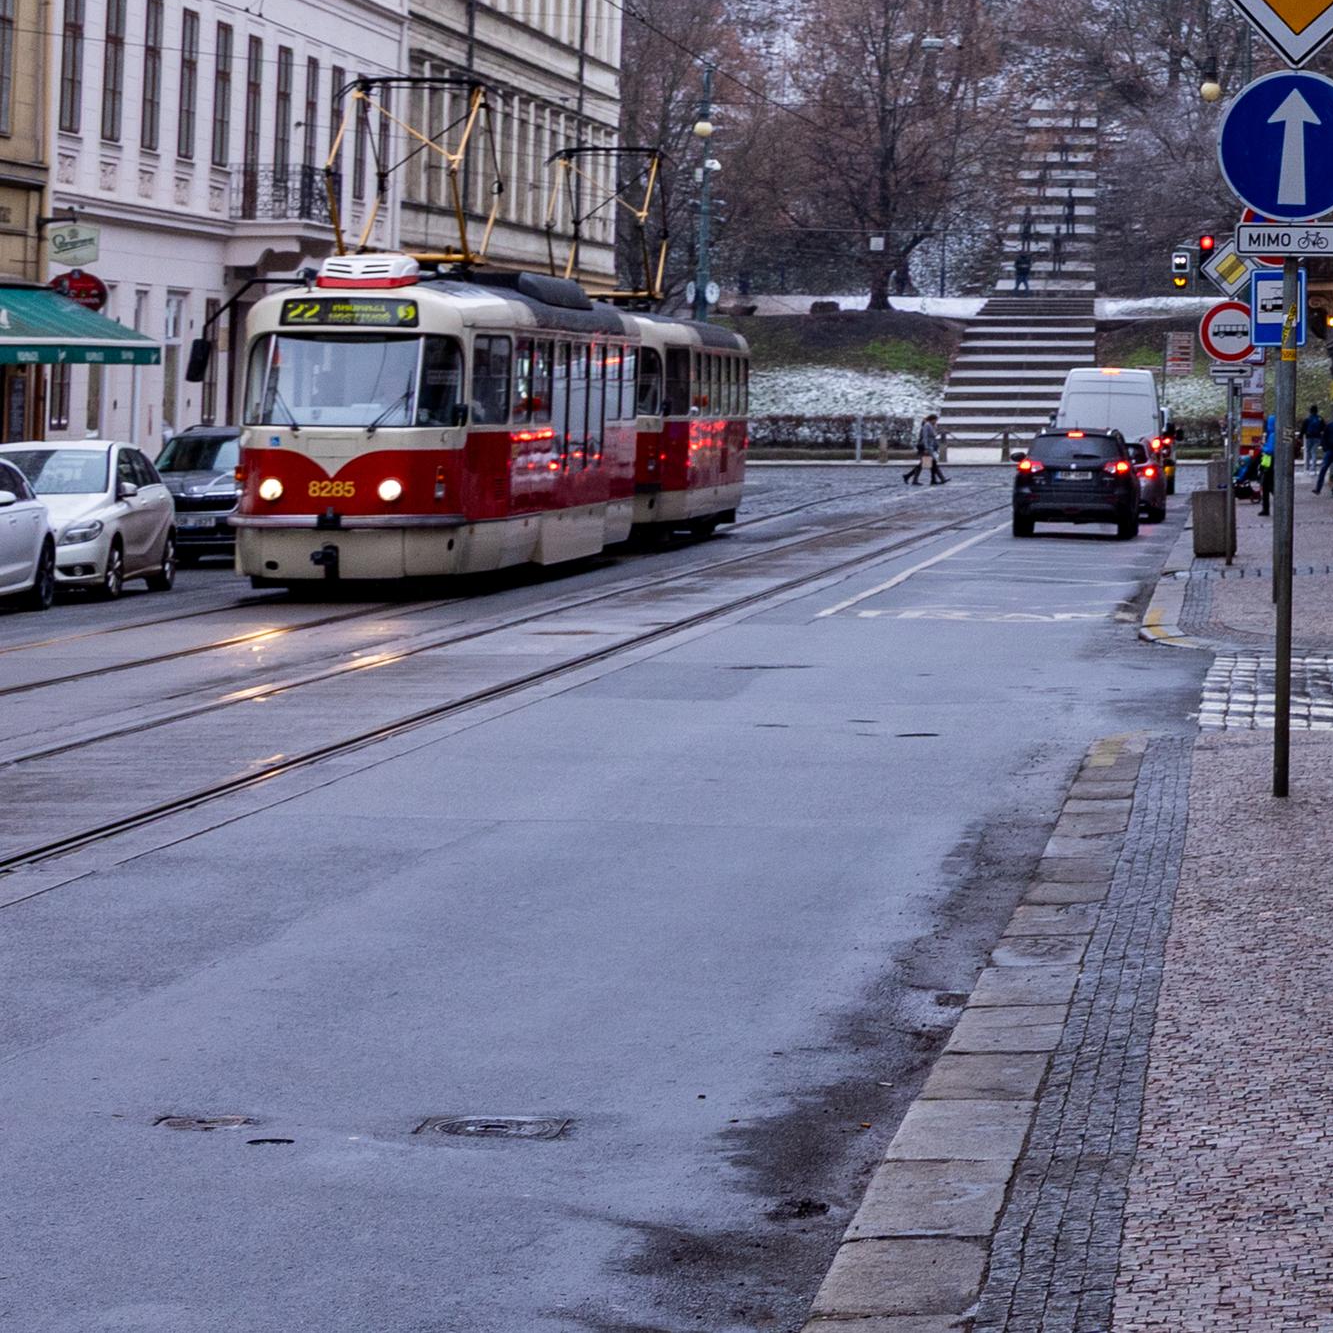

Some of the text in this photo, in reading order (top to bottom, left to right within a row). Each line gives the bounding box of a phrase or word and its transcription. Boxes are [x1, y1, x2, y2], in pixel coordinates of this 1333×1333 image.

[1248, 232, 1292, 248] MIMO
[287, 302, 321, 322] 22
[307, 480, 356, 497] 8285
